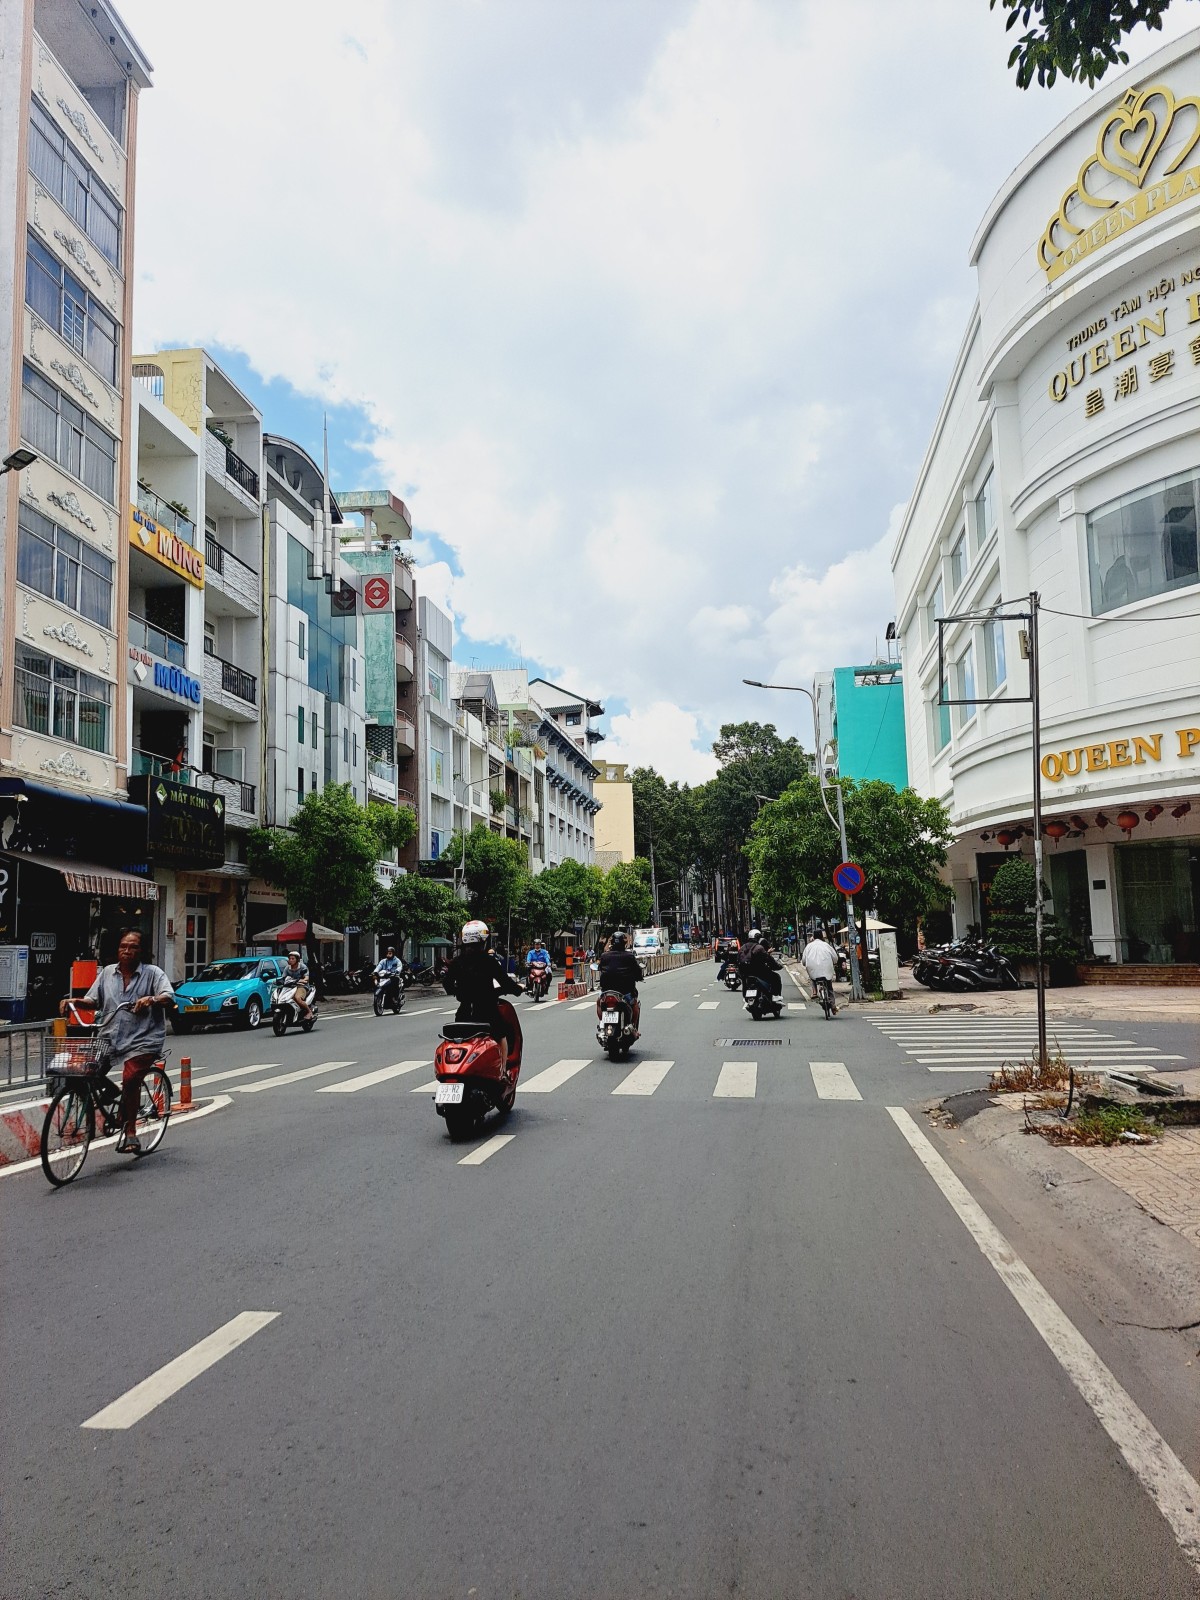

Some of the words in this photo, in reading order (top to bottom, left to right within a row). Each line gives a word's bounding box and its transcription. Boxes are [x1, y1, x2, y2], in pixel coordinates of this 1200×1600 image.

[1063, 200, 1136, 268] QUEEN
[1066, 318, 1108, 351] TRUNG
[1110, 295, 1142, 321] TÂM
[1147, 279, 1175, 303] HỘI
[1048, 307, 1168, 402] QUEEN
[1041, 734, 1163, 782] QUEEN
[170, 785, 188, 804] MẮT
[35, 953, 52, 964] VAPE
